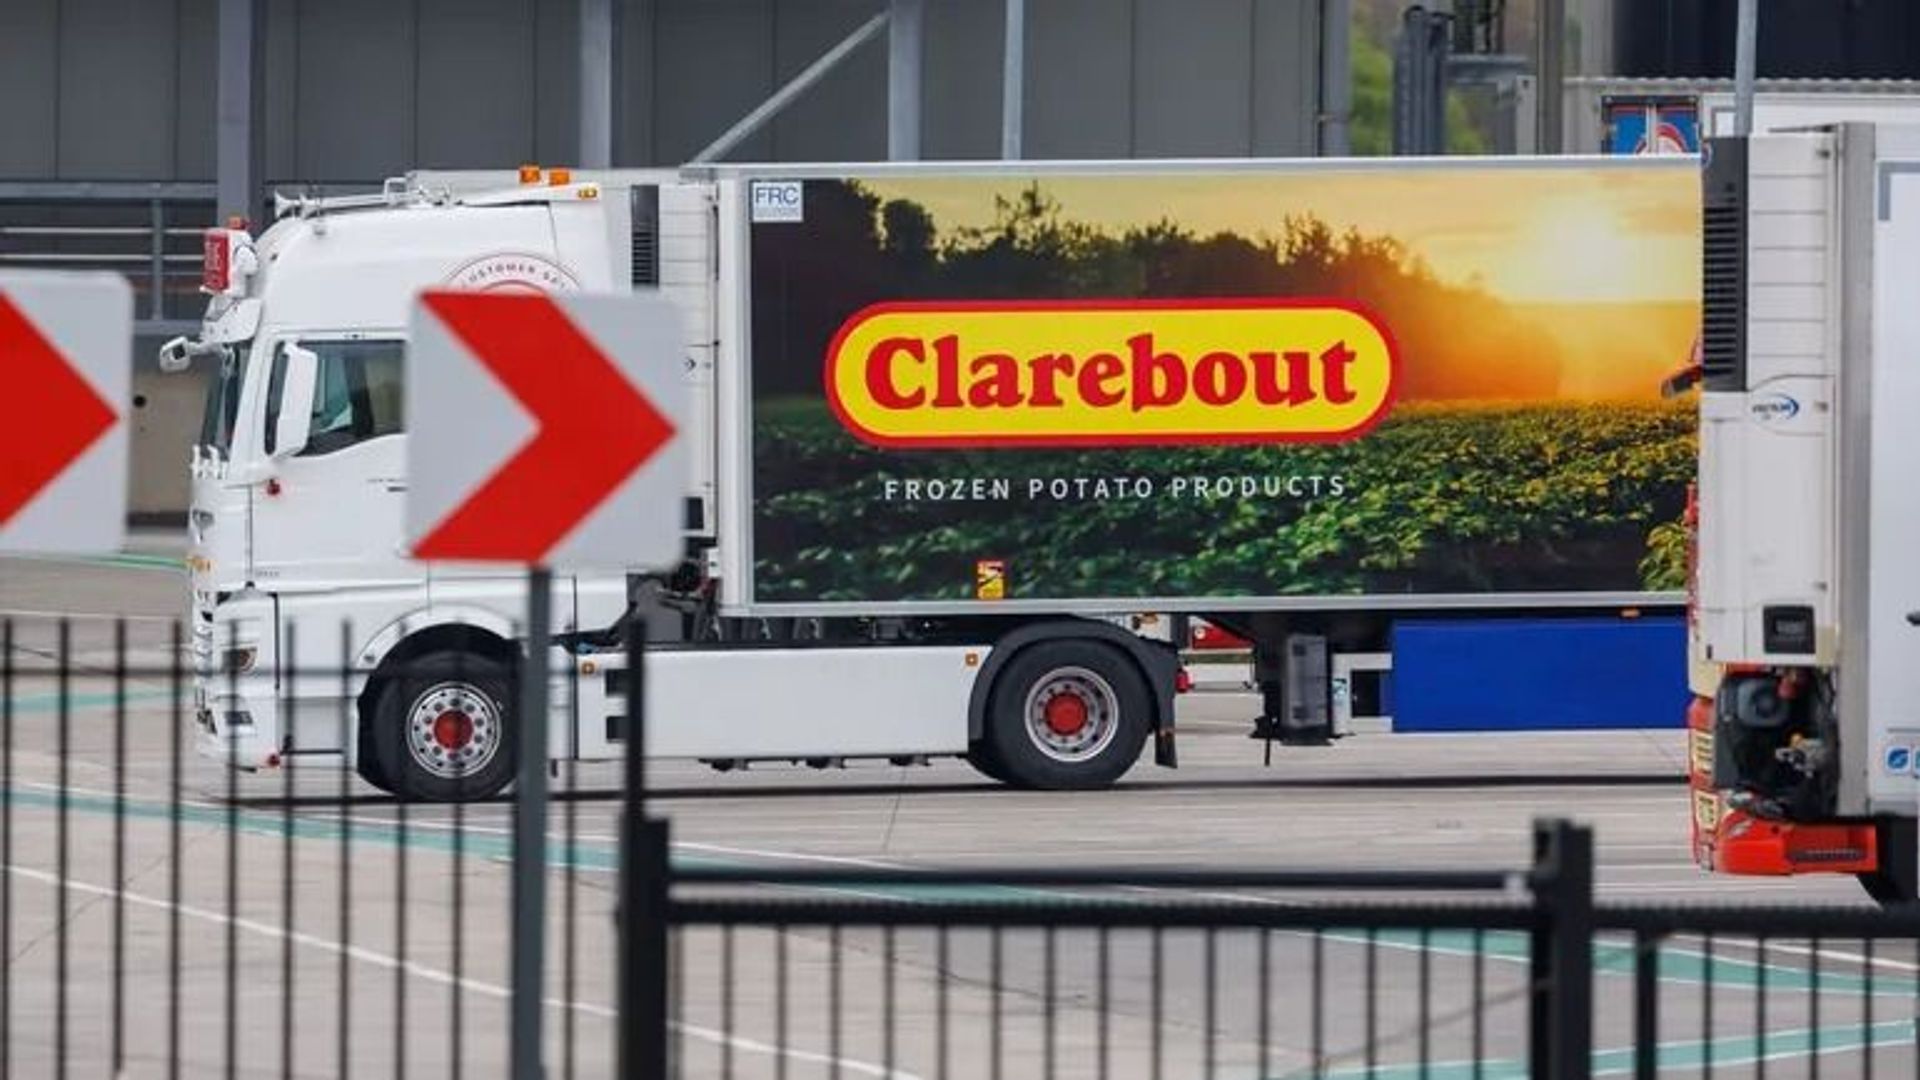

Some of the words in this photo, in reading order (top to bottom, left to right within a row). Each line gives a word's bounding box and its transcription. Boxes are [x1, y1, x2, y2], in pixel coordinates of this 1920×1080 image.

[755, 186, 799, 205] FRC
[865, 332, 1357, 412] Clarebout
[884, 479, 1009, 500] FROZEN
[1029, 478, 1153, 499] POTATO
[1172, 476, 1345, 498] PRODUCTS
